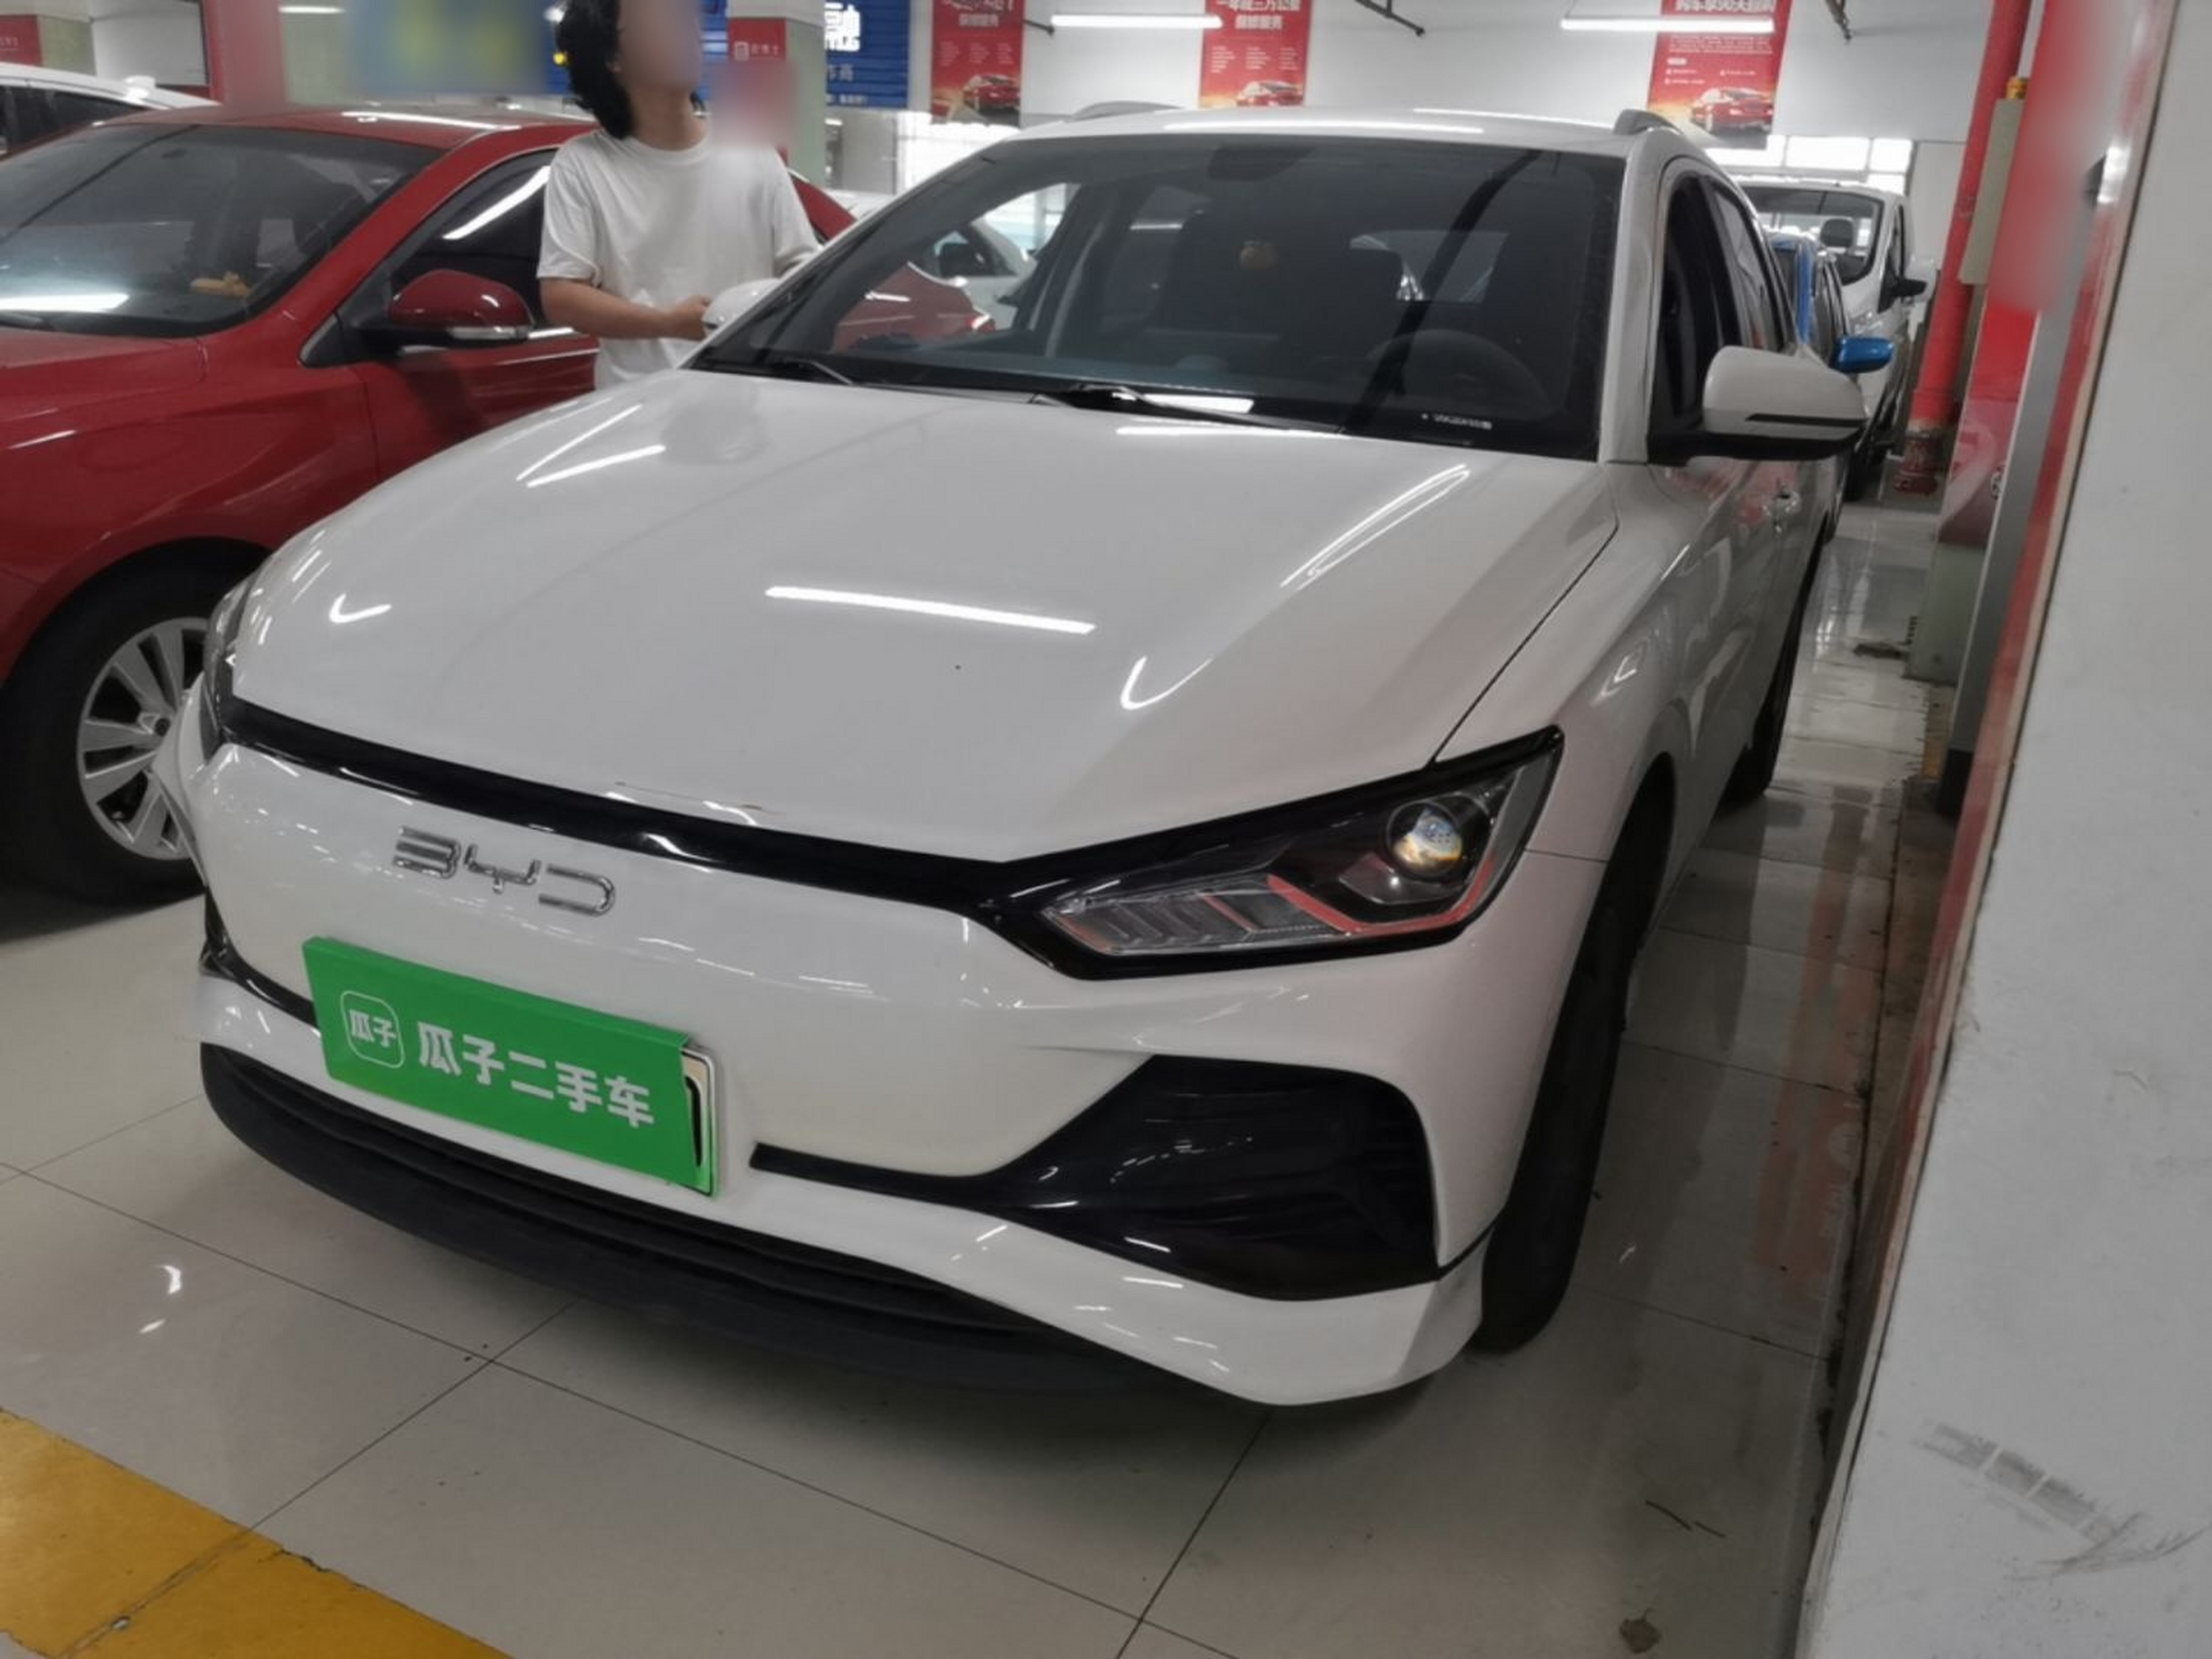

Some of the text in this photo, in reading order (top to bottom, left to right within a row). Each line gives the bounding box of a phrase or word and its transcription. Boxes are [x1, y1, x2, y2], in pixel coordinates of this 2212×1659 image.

[393, 825, 615, 917] BYD
[349, 1009, 397, 1048] 瓜子
[417, 1021, 655, 1128] 瓜子二手车
